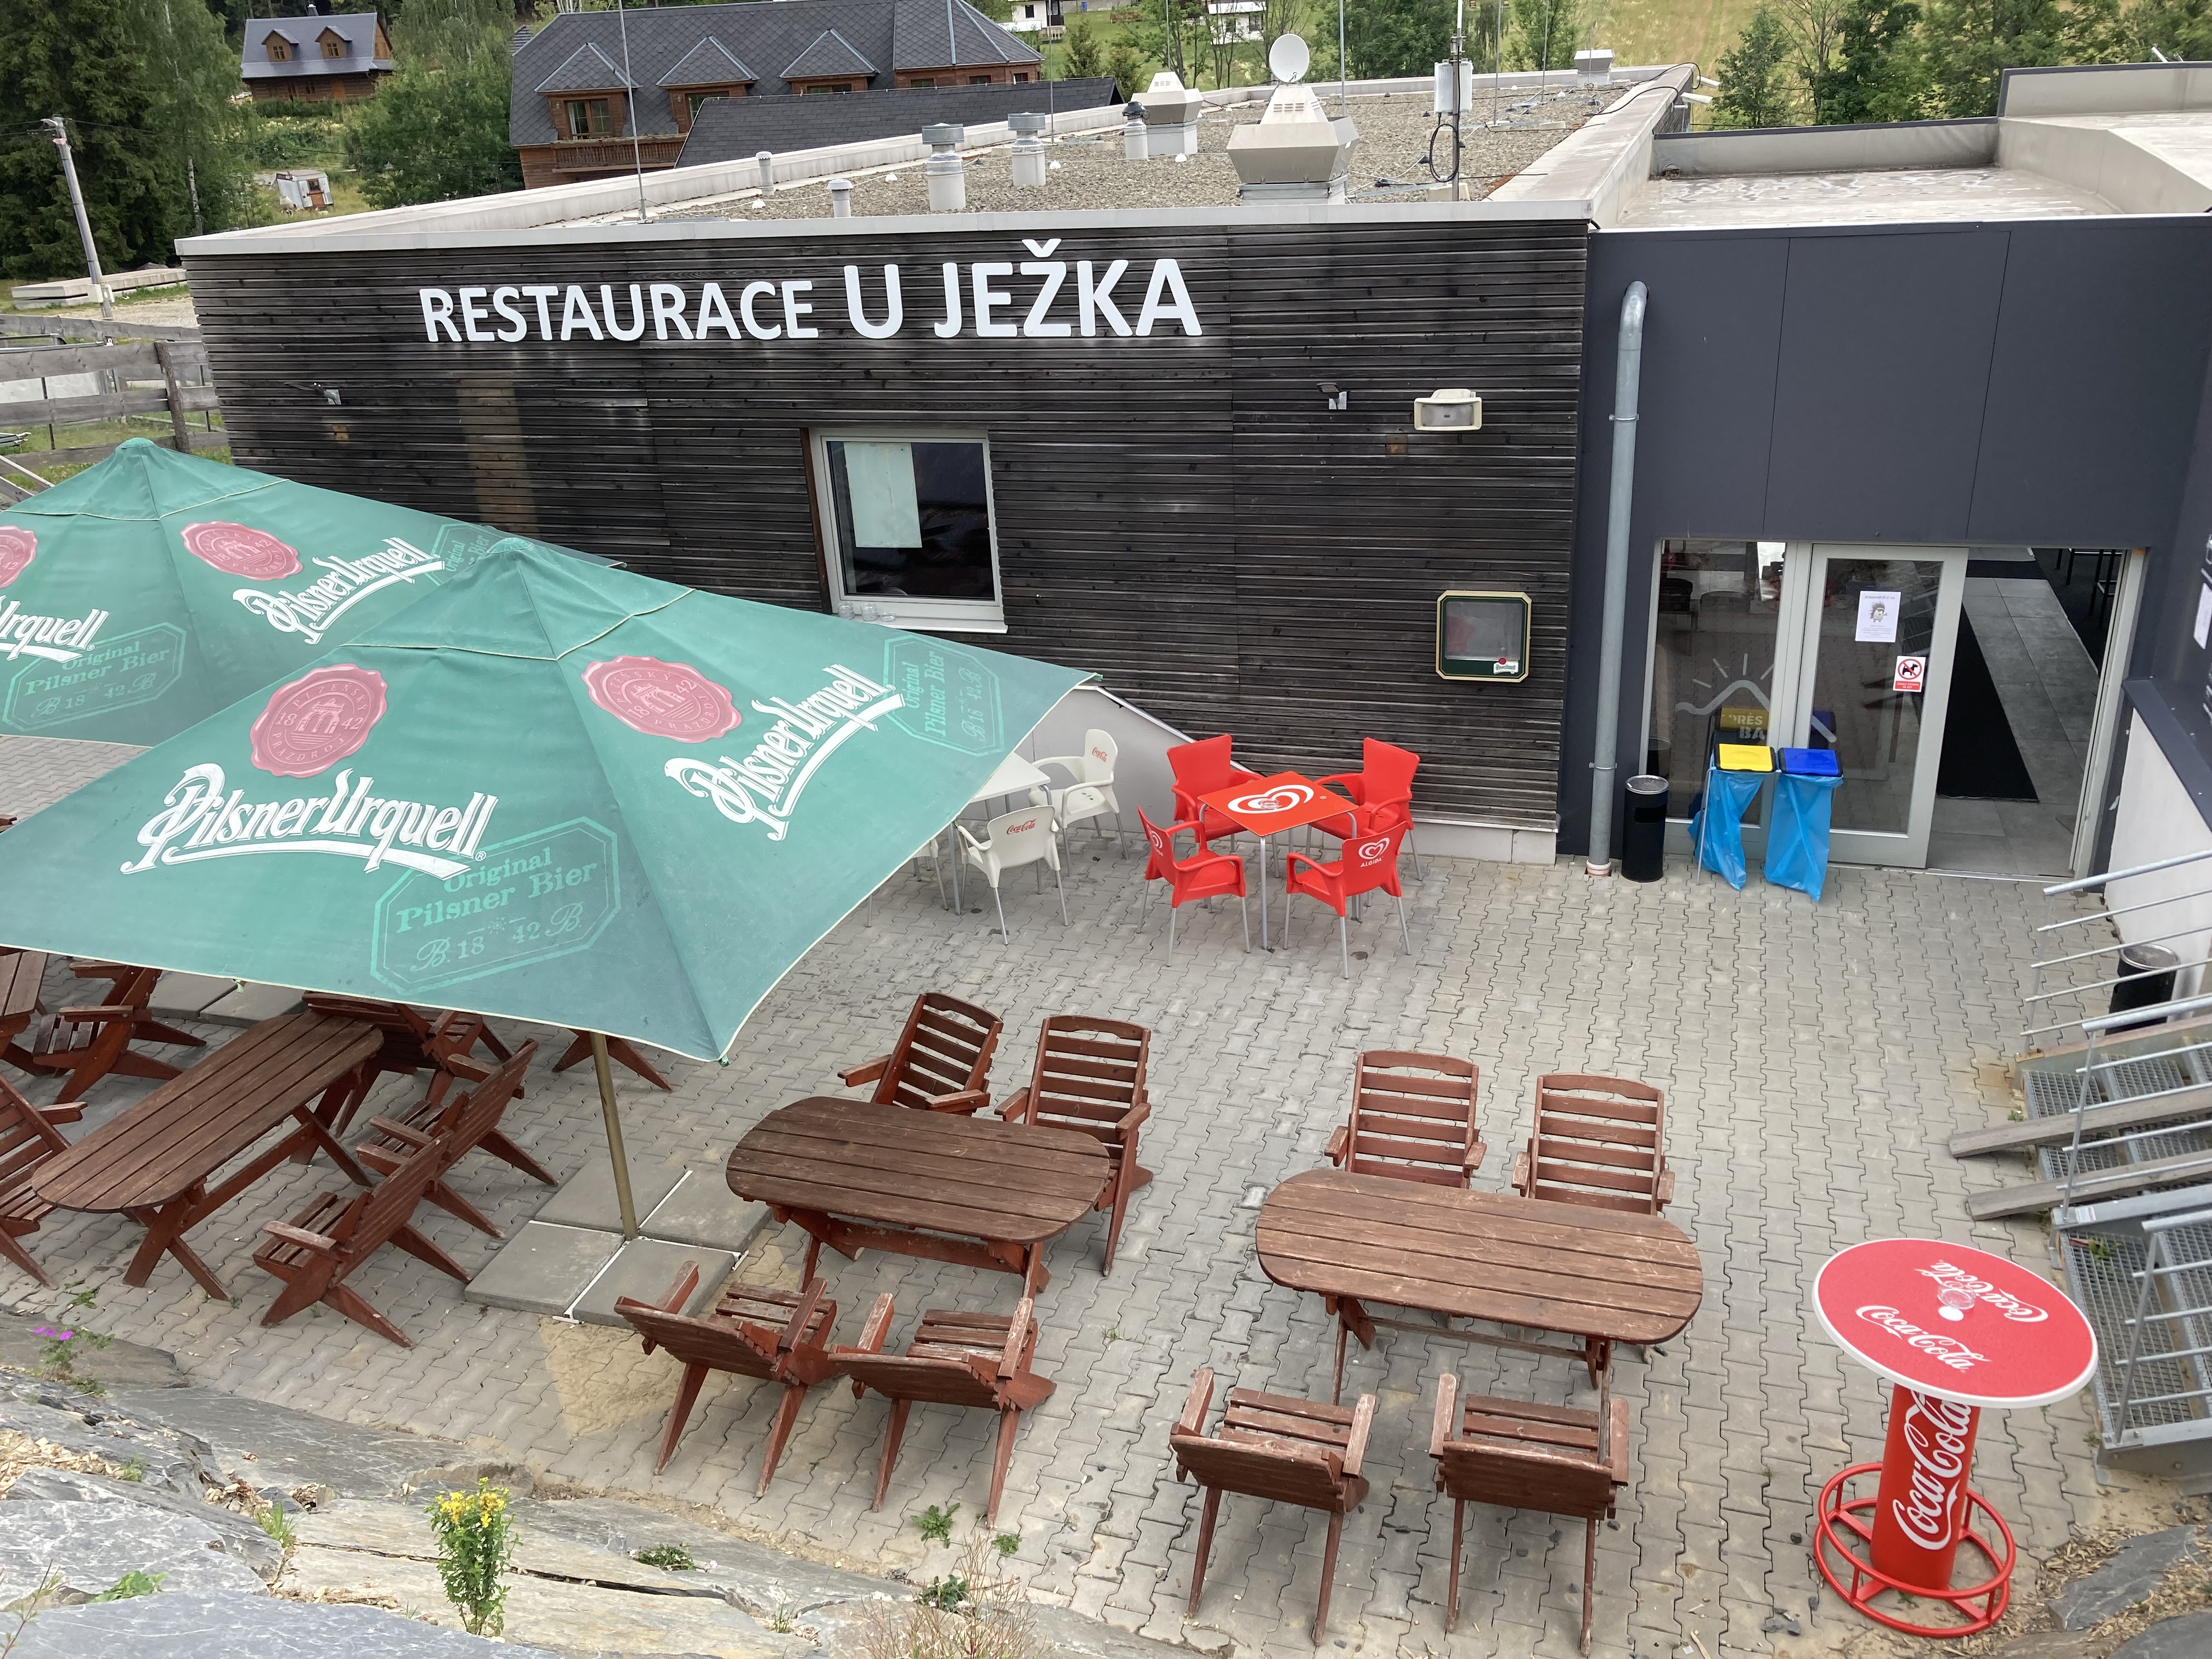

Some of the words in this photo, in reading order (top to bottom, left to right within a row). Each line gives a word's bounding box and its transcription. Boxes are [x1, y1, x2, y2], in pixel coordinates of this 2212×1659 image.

[419, 280, 819, 342] RESTAURACE
[843, 264, 903, 339] U
[934, 238, 1203, 338] JEŽKA
[213, 552, 230, 562] 18
[255, 540, 273, 549] 42
[233, 550, 284, 572] PRAZDROJ
[445, 540, 466, 572] Original
[24, 665, 112, 696] Pilsner
[119, 649, 170, 673] Bier
[61, 641, 140, 670] Original
[924, 651, 945, 684] Bier
[65, 695, 85, 709] 18
[104, 684, 125, 698] 42
[292, 682, 369, 712] PLZEŇSKÝ
[627, 706, 651, 719] 18
[675, 679, 698, 695] 42
[901, 660, 924, 708] Original
[275, 712, 297, 727] 18
[341, 717, 364, 730] 42
[654, 695, 715, 730] PRAZDROJ
[924, 684, 946, 737] Pilsner
[272, 732, 345, 761] PRAZDROJ
[443, 847, 552, 893] Original
[1360, 856, 1383, 867] ALGIDA
[395, 886, 516, 933] Pilsner
[528, 862, 597, 899] Bier
[457, 935, 485, 960] 18
[512, 922, 540, 944] 42
[1914, 1261, 2049, 1322] Coca-Cola
[1855, 1305, 1993, 1370] Coca-Cola
[1892, 1390, 1972, 1550] Coca-Cola
